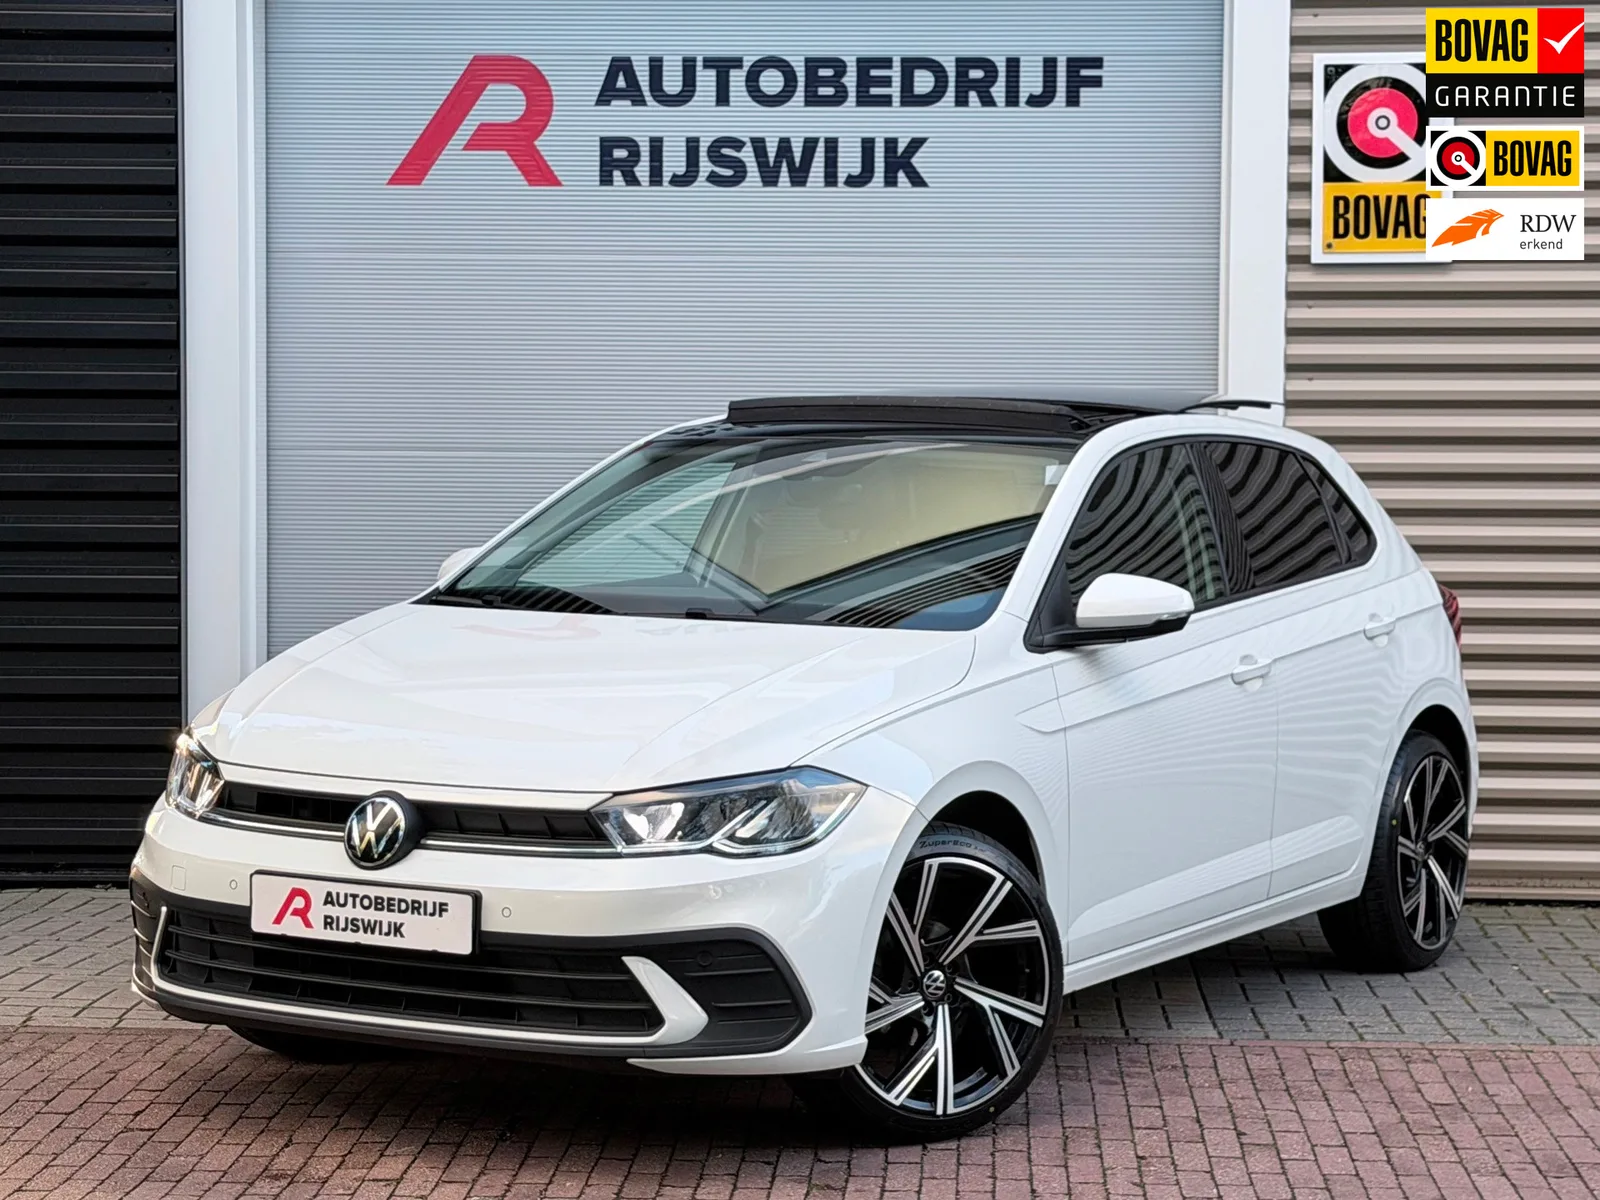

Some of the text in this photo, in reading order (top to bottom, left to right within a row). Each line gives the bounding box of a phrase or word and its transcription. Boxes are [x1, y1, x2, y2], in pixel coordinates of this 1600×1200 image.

[594, 55, 1105, 109] AUTOBEDRIJF
[598, 136, 931, 189] RIJSWIJK
[322, 890, 449, 918] AUTOBEDRIJF
[322, 914, 406, 938] RIJSWIJK
